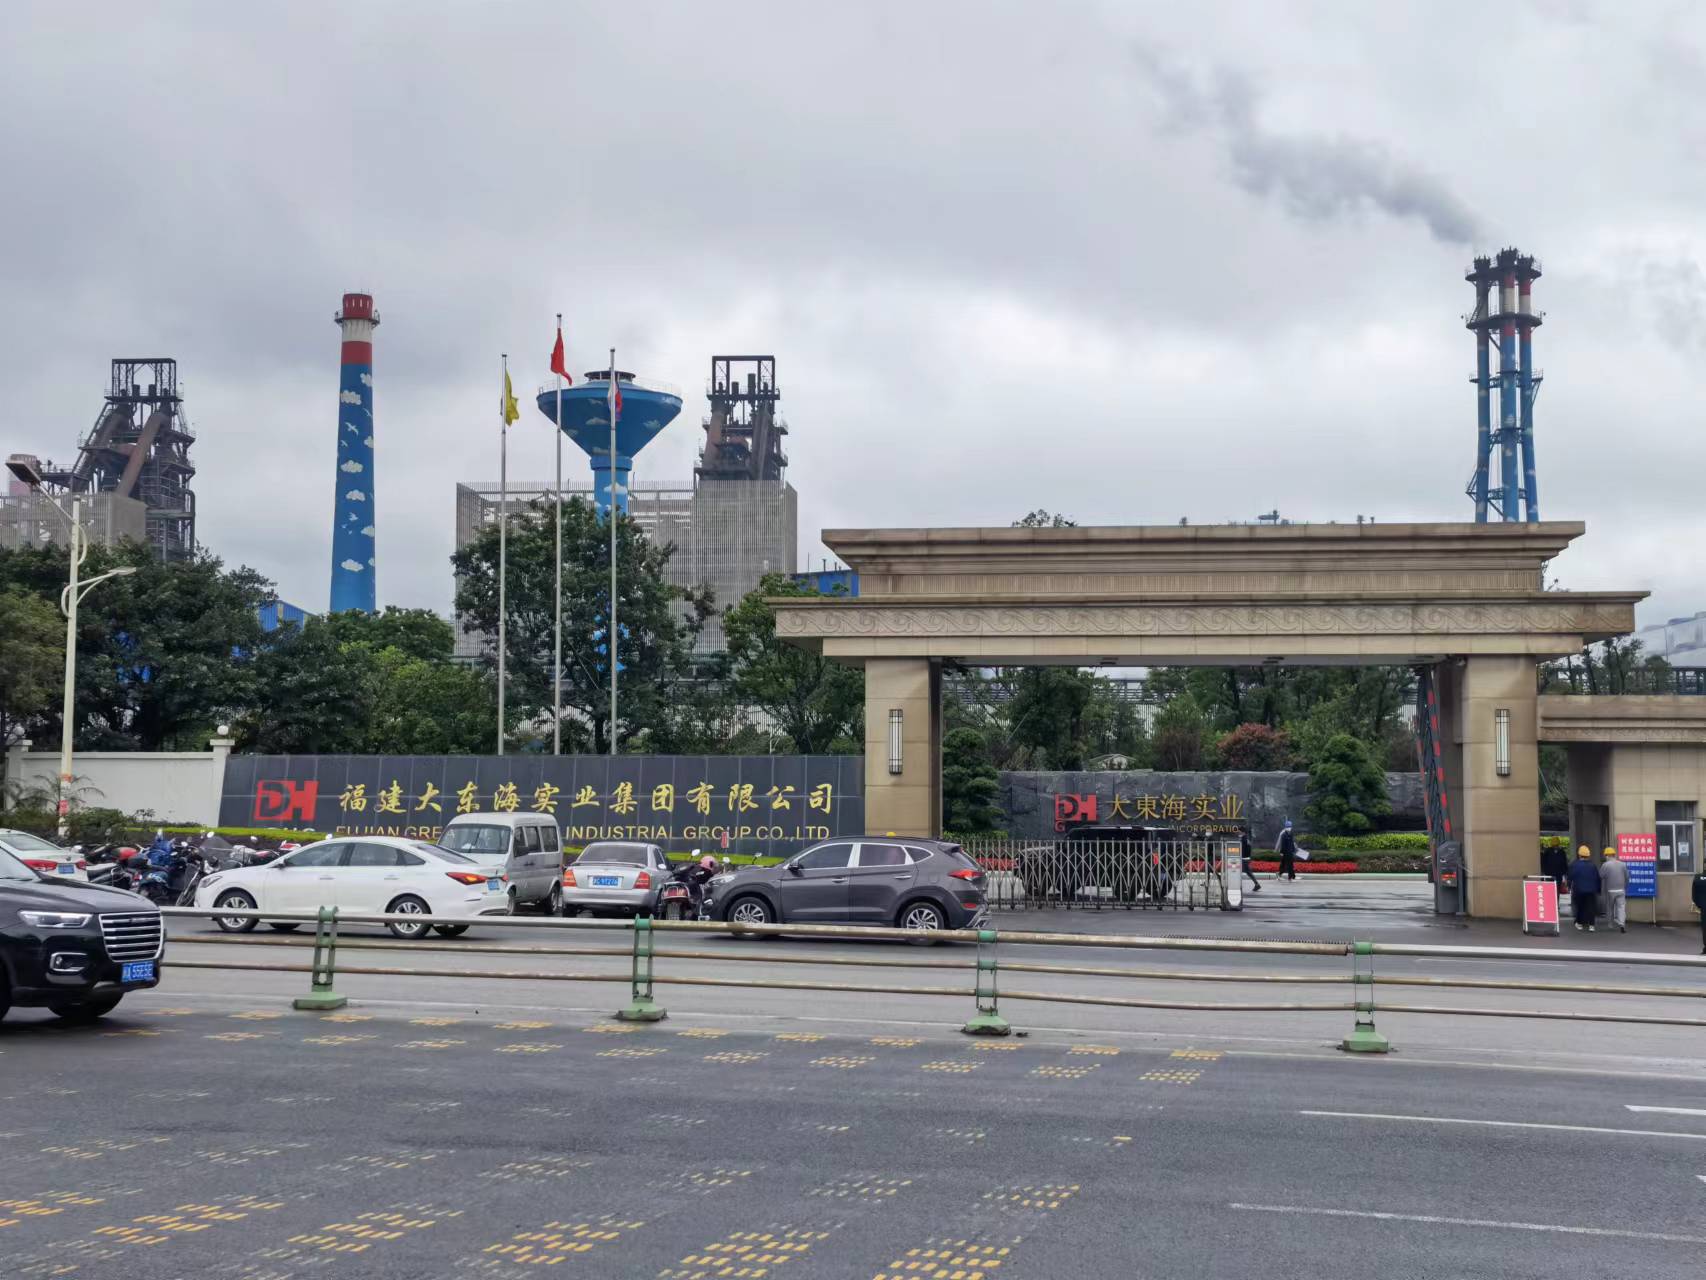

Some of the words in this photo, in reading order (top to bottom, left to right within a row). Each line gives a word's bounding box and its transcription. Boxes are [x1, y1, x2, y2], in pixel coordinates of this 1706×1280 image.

[338, 779, 834, 815] 福建大东海实业集团有限公司
[1105, 793, 1248, 821] 大東海实业
[565, 826, 673, 840] INDUSTRIAL
[683, 826, 752, 840] GROUP
